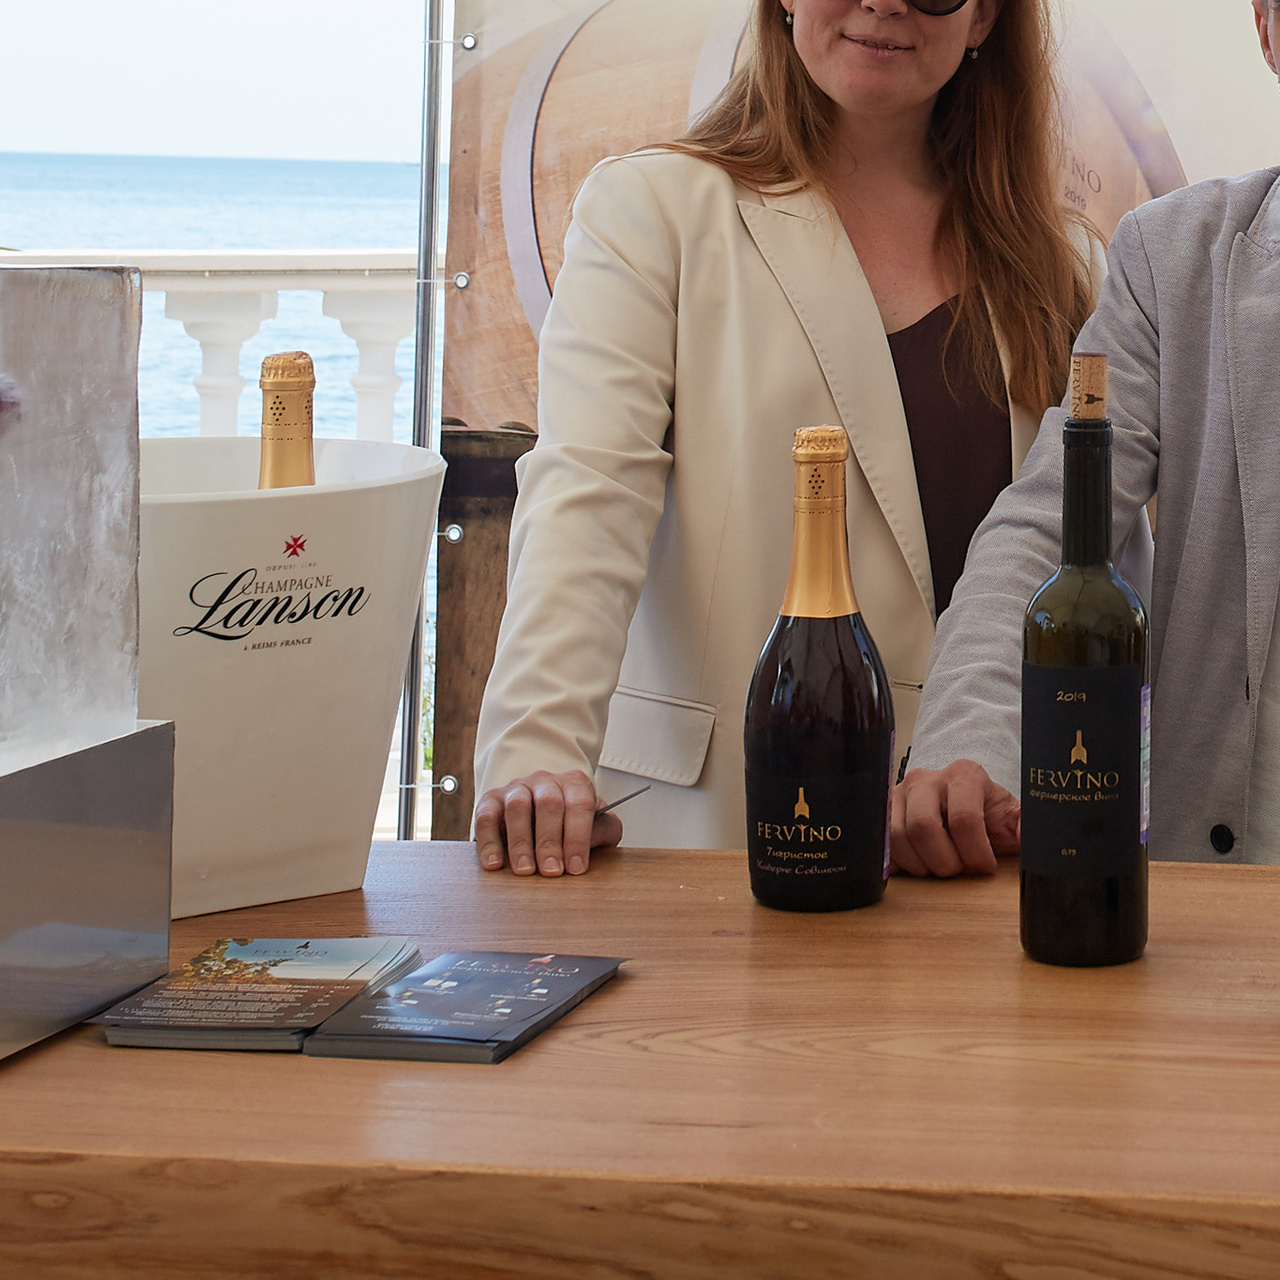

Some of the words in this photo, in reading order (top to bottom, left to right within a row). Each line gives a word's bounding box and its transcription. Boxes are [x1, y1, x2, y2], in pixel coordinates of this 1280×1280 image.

[1064, 186, 1087, 211] 2019
[242, 574, 333, 596] CHAMPAGNE
[173, 568, 371, 640] Lanson
[251, 641, 277, 651] REIMS
[1056, 691, 1087, 703] 2019
[1030, 767, 1119, 789] FERVINO
[757, 822, 842, 842] FERVINO
